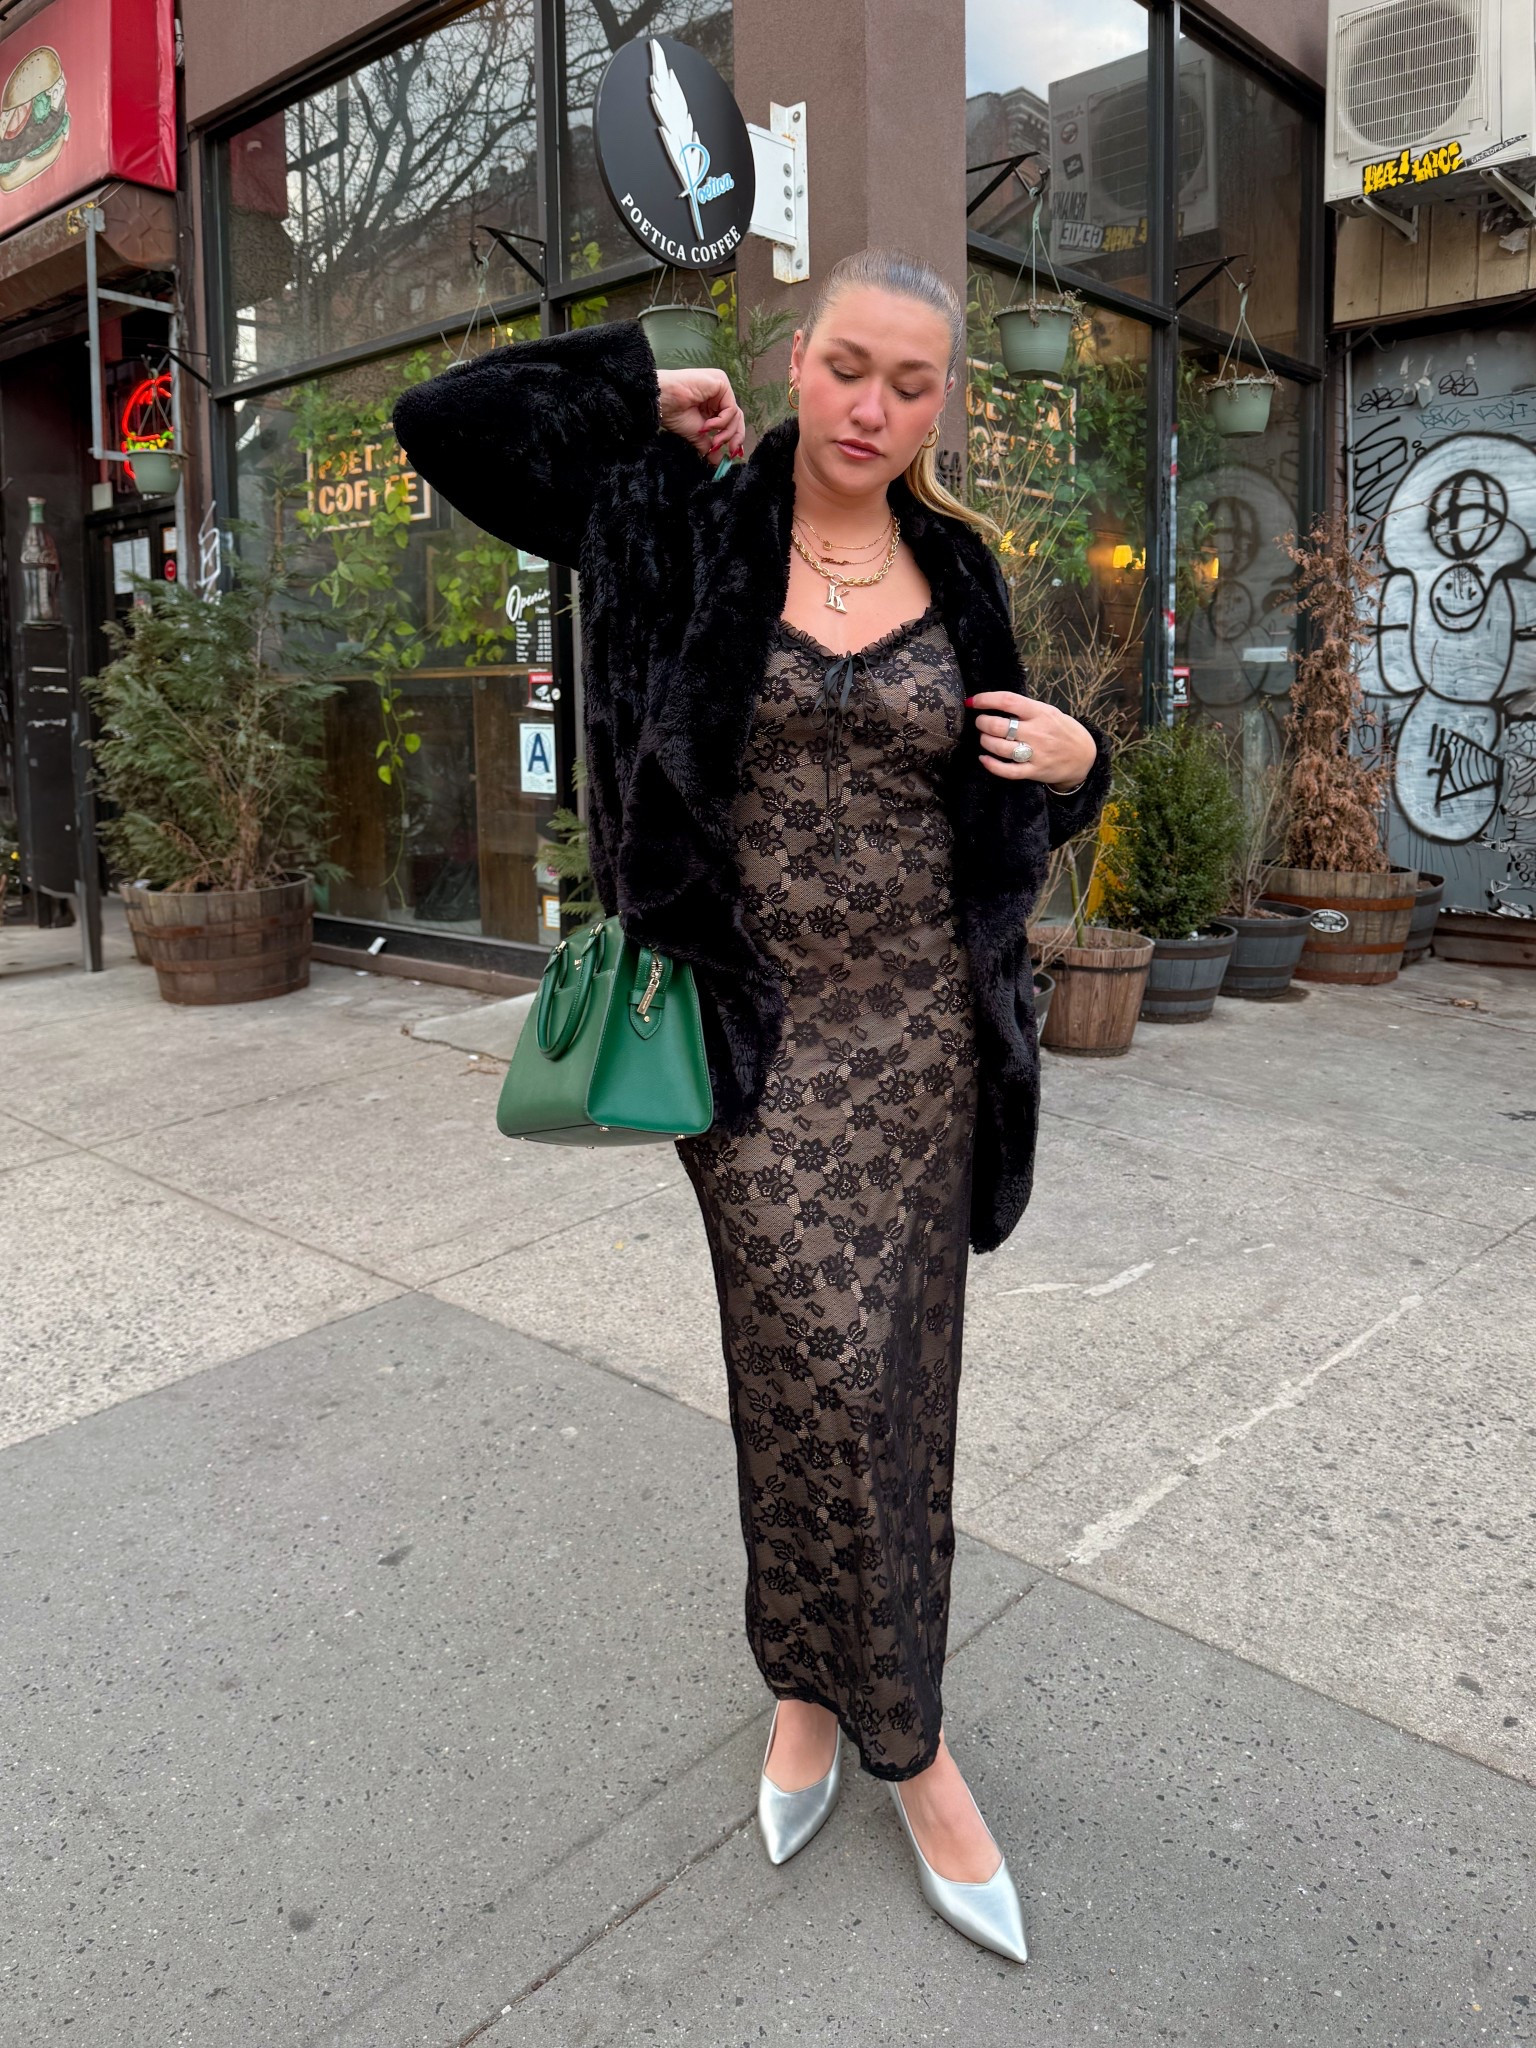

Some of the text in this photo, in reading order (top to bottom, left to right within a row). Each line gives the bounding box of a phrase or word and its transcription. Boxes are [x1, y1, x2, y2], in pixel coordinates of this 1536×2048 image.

[678, 143, 735, 205] Poetica
[620, 192, 742, 263] POETICA COFFEE
[505, 585, 551, 622] Openin
[527, 732, 550, 773] A
